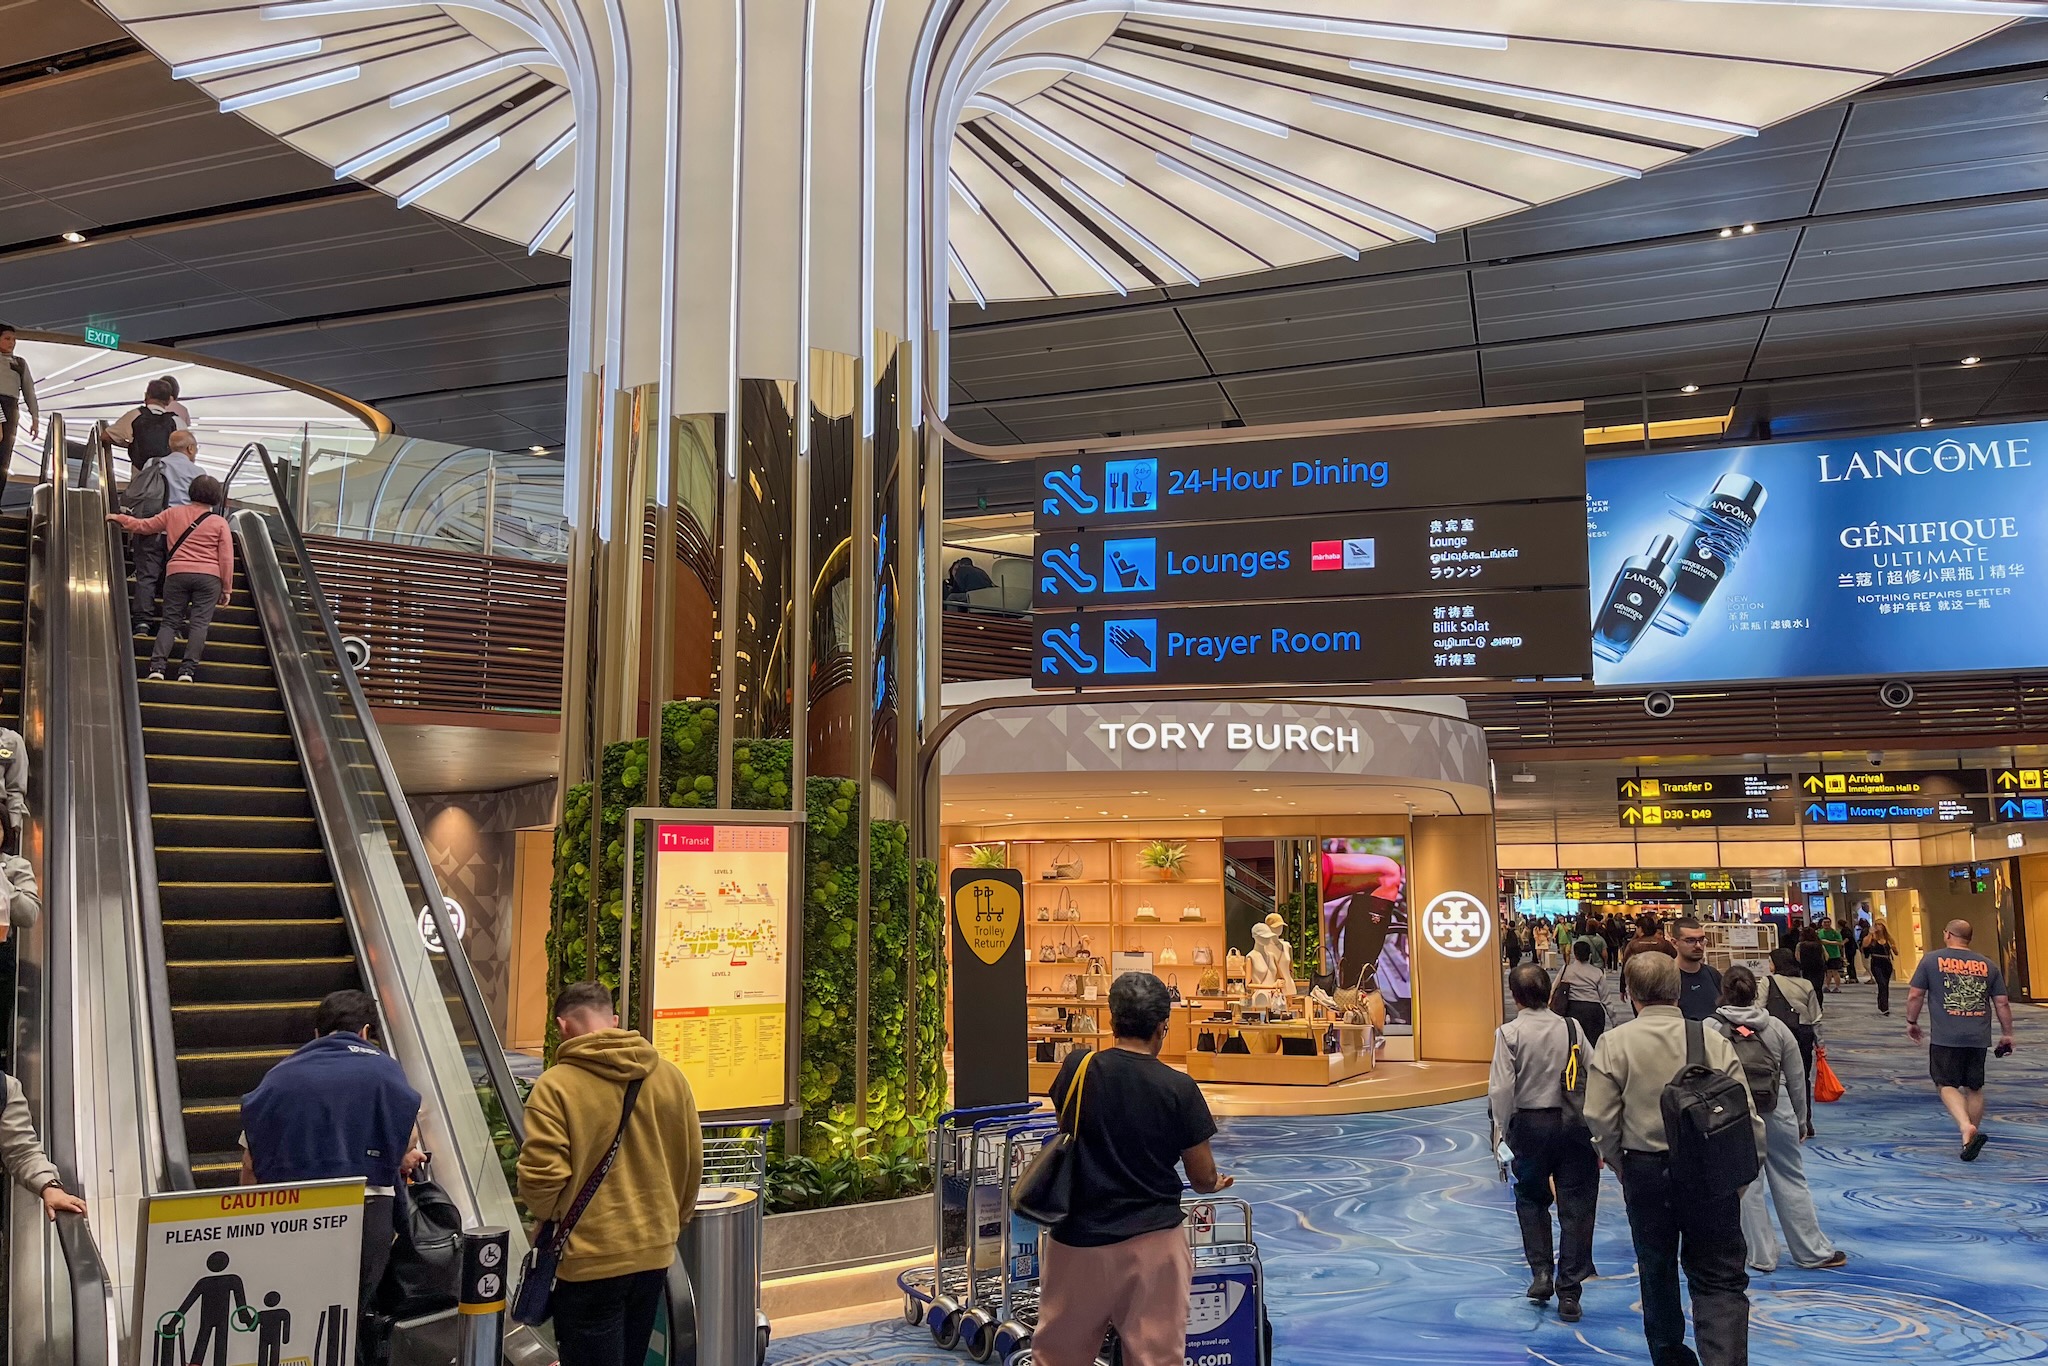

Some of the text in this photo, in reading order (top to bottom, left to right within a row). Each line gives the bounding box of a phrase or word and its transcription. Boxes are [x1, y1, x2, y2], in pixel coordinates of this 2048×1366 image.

[88, 330, 110, 344] EXIT
[1817, 438, 2031, 482] LANCÔME
[1168, 457, 1389, 495] 24-Hour Dining
[1430, 518, 1474, 533] 贵宾室
[1839, 516, 2019, 549] GÉNIFIQUE
[1430, 536, 1467, 548] Lounge
[1167, 550, 1291, 578] Lounges
[1873, 547, 1989, 568] ULTIMATE
[1430, 565, 1482, 579] ラウンジ
[1624, 572, 1665, 598] LANCÔME
[1857, 587, 2011, 603] NOTHING REPAIRS BETTER
[1433, 605, 1475, 619] 祈祷室
[1727, 602, 1764, 611] LOTION
[1433, 620, 1490, 633] Bilik Solat
[1168, 628, 1361, 662] Prayer Room
[1099, 722, 1359, 753] TORY BURCH
[1848, 773, 1884, 783] Arrival
[1662, 782, 1712, 792] Transfer D
[1848, 785, 1895, 794] Immigration
[1663, 810, 1682, 819] D30
[1691, 809, 1712, 819] D49
[1850, 806, 1887, 818] Money
[1889, 805, 1935, 817] Changer
[662, 833, 677, 845] T1
[681, 836, 709, 845] Transit
[974, 926, 1005, 938] Trolley
[974, 939, 1006, 948] Return
[1938, 957, 1988, 973] MAMBO
[221, 1189, 300, 1210] CAUTION
[165, 1215, 348, 1244] PLEASE MIND YOUR STEP
